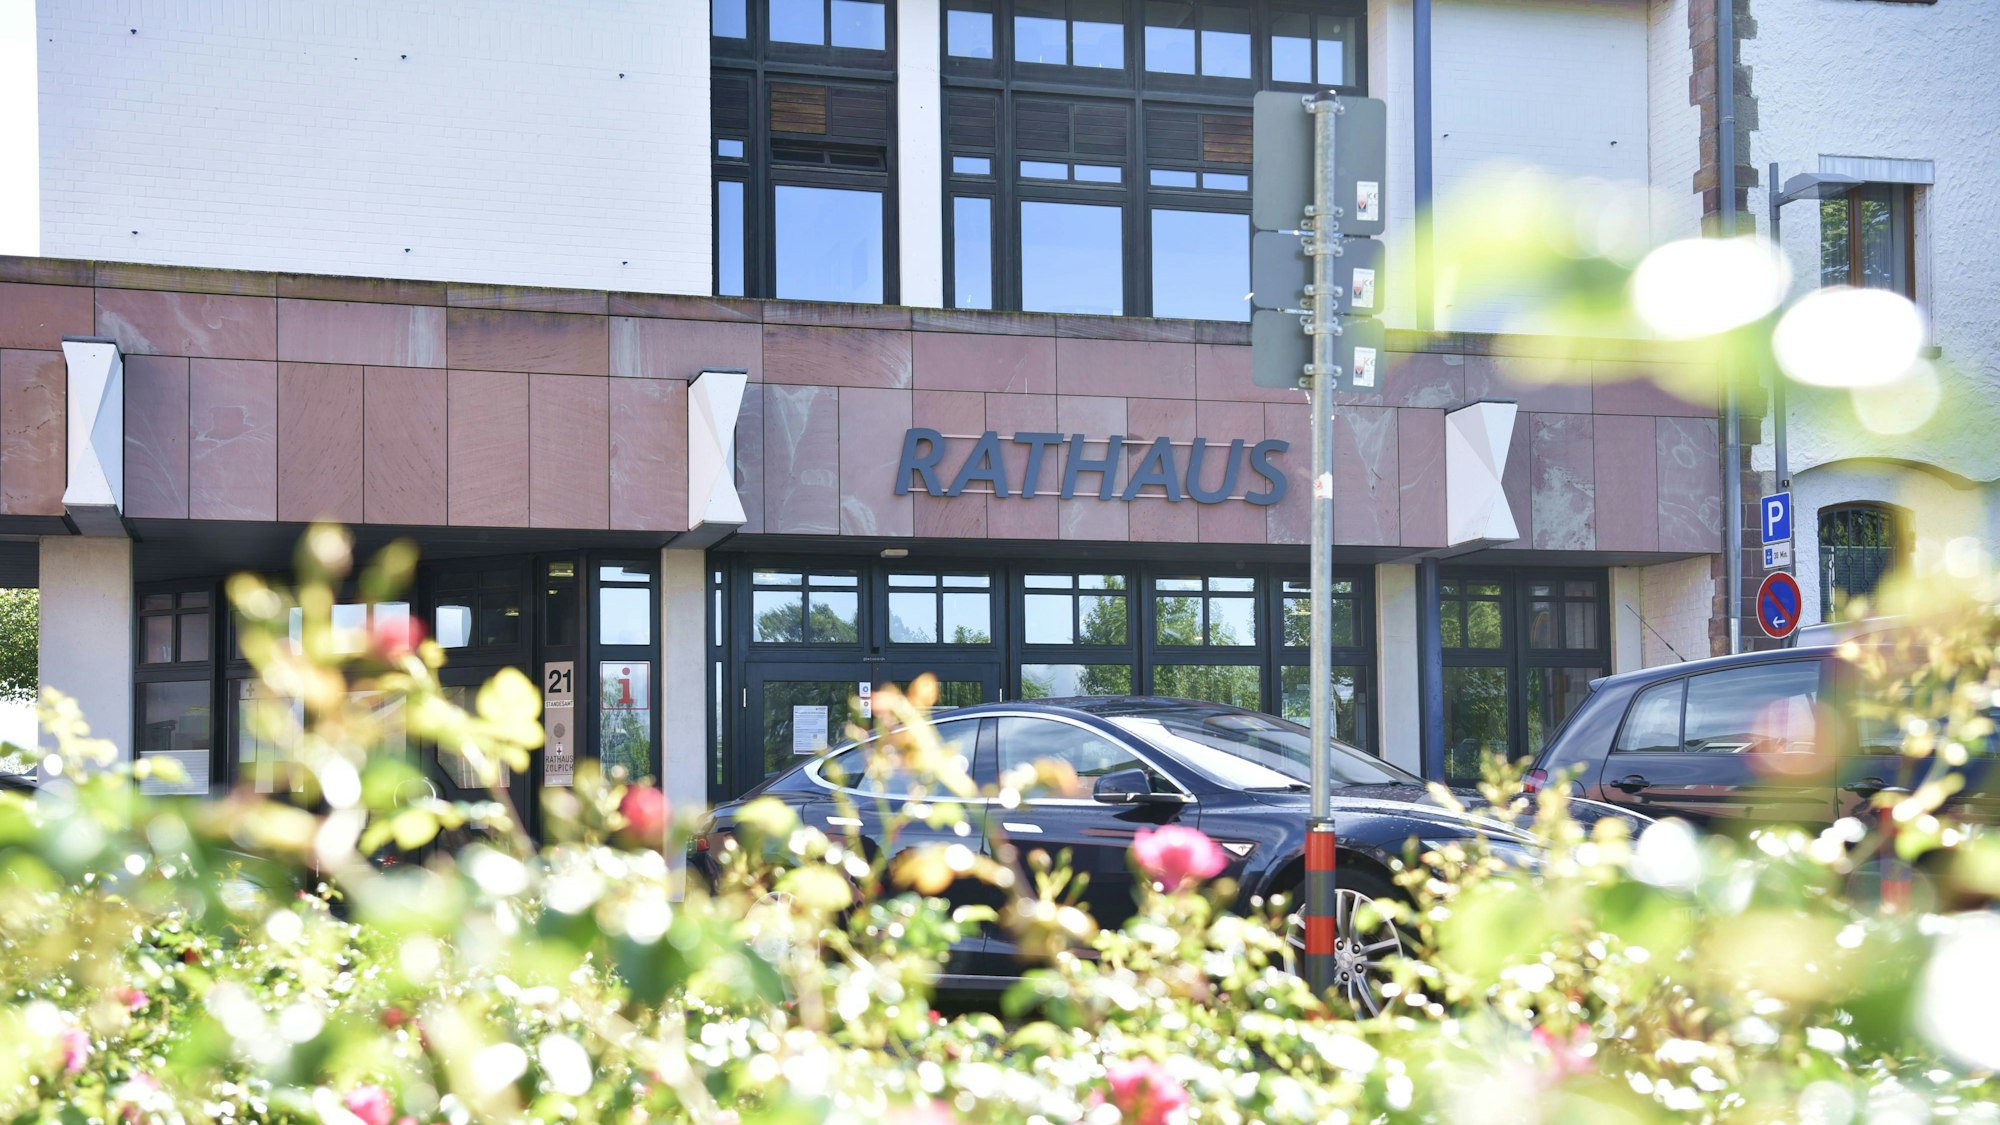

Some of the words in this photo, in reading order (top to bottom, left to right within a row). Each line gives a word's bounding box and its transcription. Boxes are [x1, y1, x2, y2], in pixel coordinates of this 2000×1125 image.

[895, 427, 1290, 506] RATHAUS
[1768, 501, 1783, 536] P
[548, 669, 572, 693] 21
[618, 667, 634, 704] i
[545, 755, 573, 763] RATHAUS
